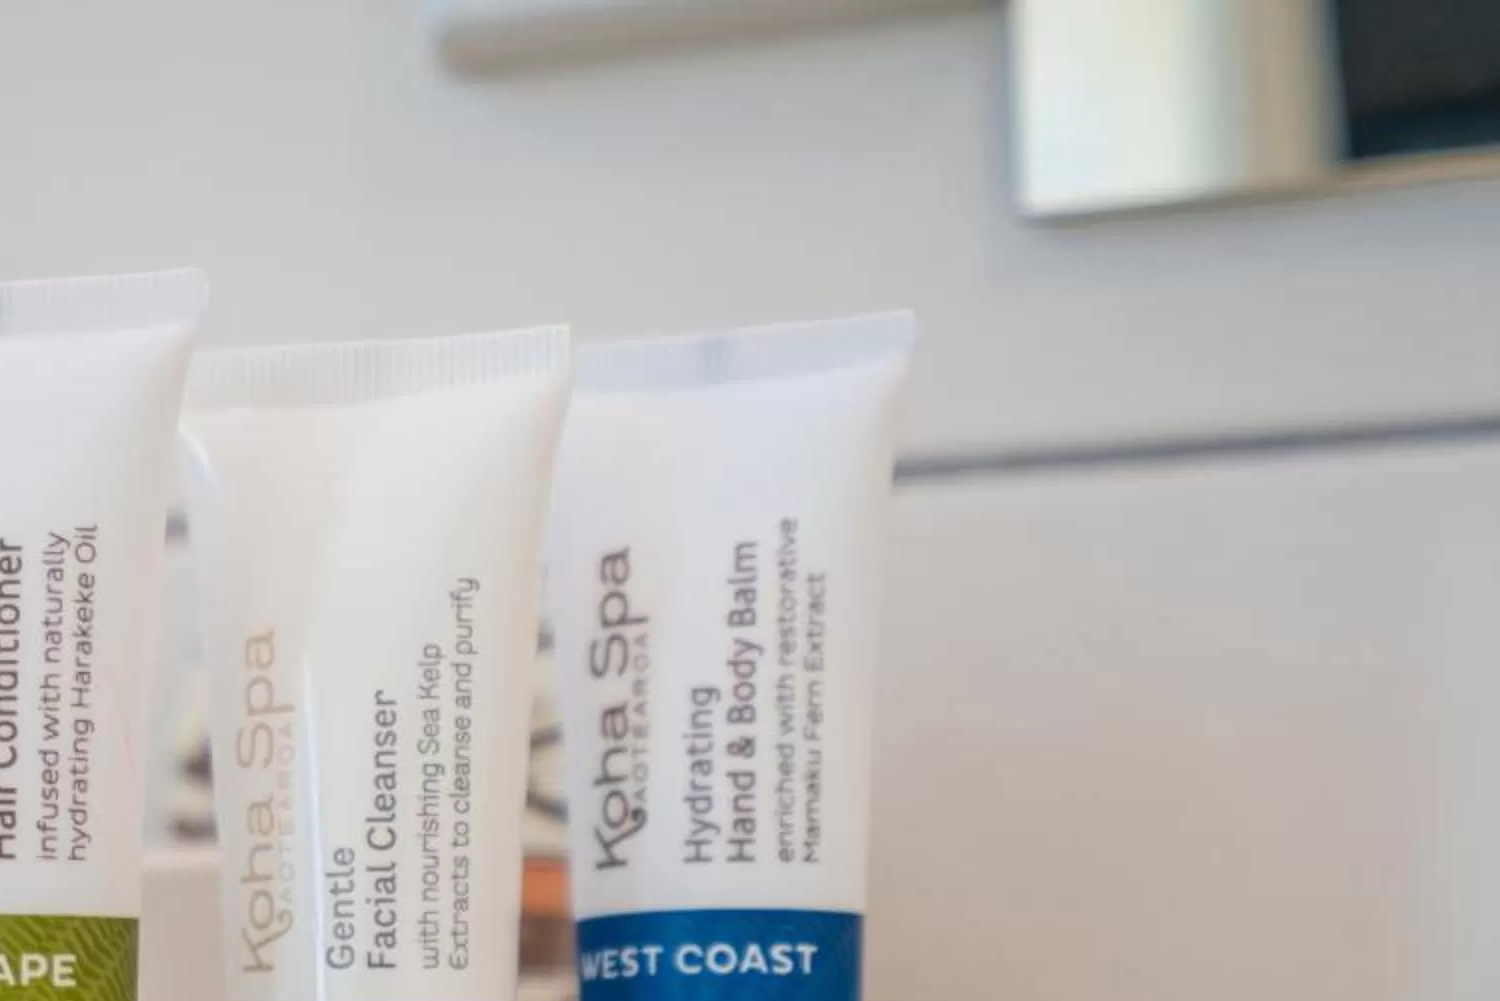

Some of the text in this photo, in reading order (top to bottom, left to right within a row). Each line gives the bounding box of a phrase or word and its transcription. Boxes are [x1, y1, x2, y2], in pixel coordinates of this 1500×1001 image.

[36, 531, 71, 861] infused with naturally
[68, 524, 98, 862] hydrating Harakeke Oil
[235, 629, 296, 974] Koha Spa
[366, 688, 397, 970] Facial Cleanser
[417, 643, 445, 970] with nourishing Sea Kelp
[448, 577, 480, 970] Extracts to cleanse and purify
[589, 547, 650, 871] Koha Spa
[682, 686, 721, 864] Hydrating
[725, 540, 764, 864] Hand & Body Balm
[775, 516, 799, 864] enriched with restorative
[803, 571, 826, 865] Mamaku Fern Extract
[325, 846, 355, 970] Gentle
[583, 942, 819, 980] WEST COAST
